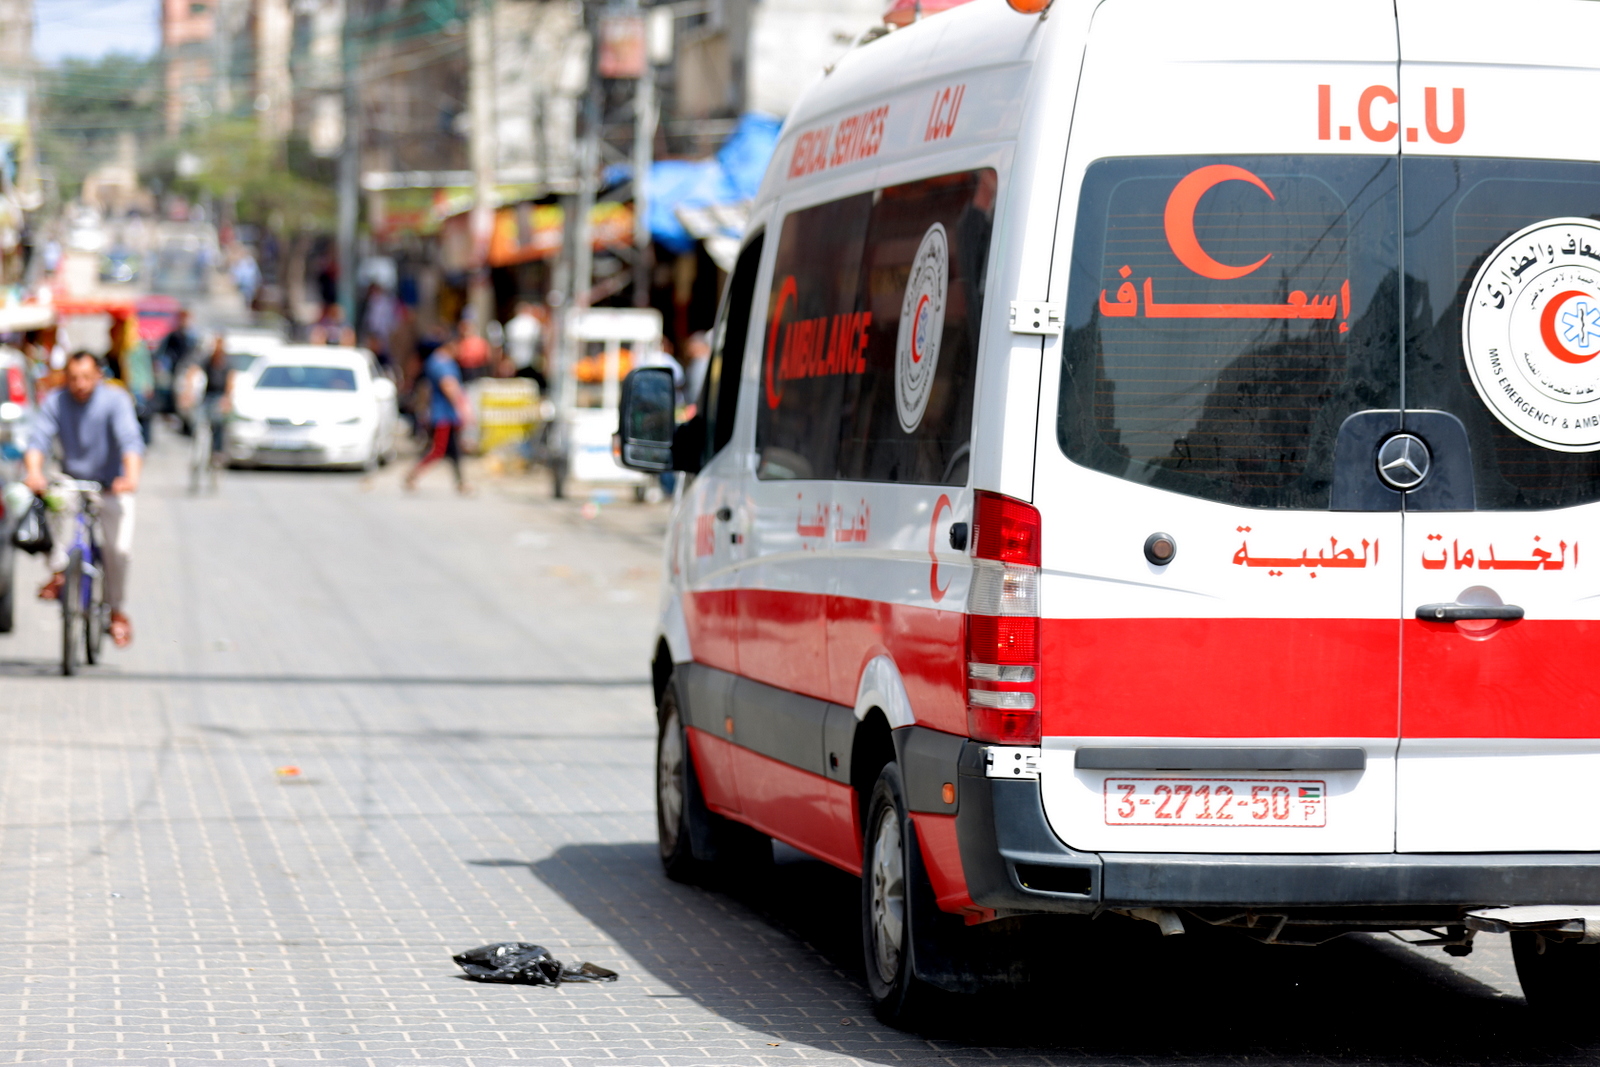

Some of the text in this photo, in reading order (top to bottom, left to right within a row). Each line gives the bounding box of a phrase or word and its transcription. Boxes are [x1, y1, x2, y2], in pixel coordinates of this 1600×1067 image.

[830, 104, 890, 168] SERVICES
[924, 84, 966, 142] I.C.U
[1318, 84, 1465, 144] I.C.U
[1100, 265, 1350, 334] إسعاف
[778, 311, 873, 380] AMBULANCE
[1489, 348, 1600, 429] MMS EMERGENCY & AMB
[1232, 525, 1579, 579] الخدمات الطبية
[1117, 784, 1291, 820] 3-2712-50
